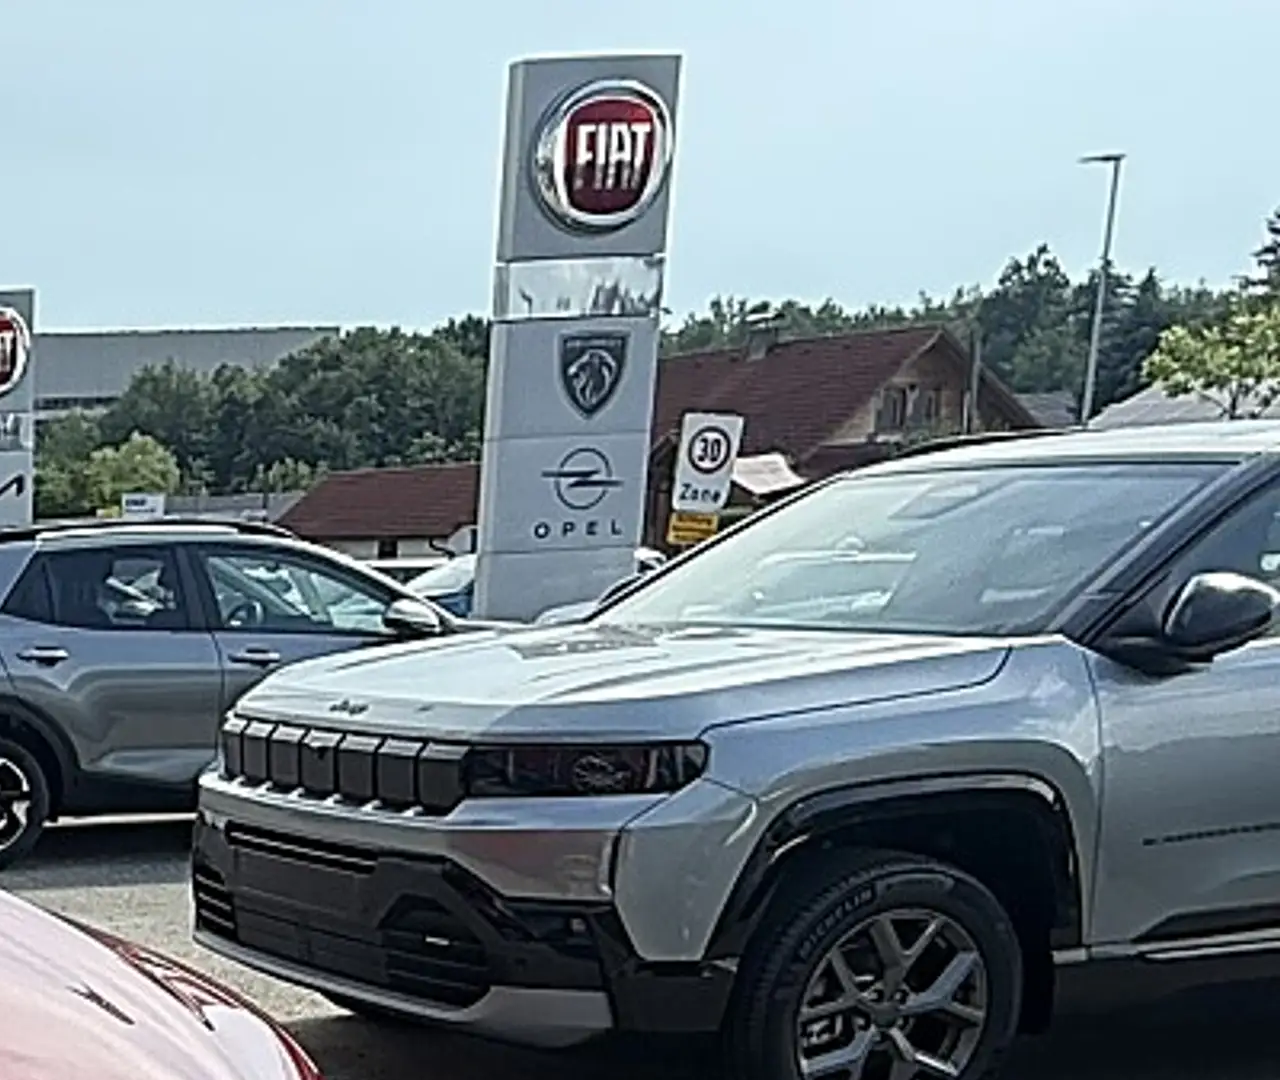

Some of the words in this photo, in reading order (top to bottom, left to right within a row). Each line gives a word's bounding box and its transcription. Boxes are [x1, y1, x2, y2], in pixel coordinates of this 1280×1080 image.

[573, 122, 652, 191] FIAT
[698, 437, 722, 462] 30
[679, 483, 722, 503] Zone
[533, 518, 623, 539] OPEL
